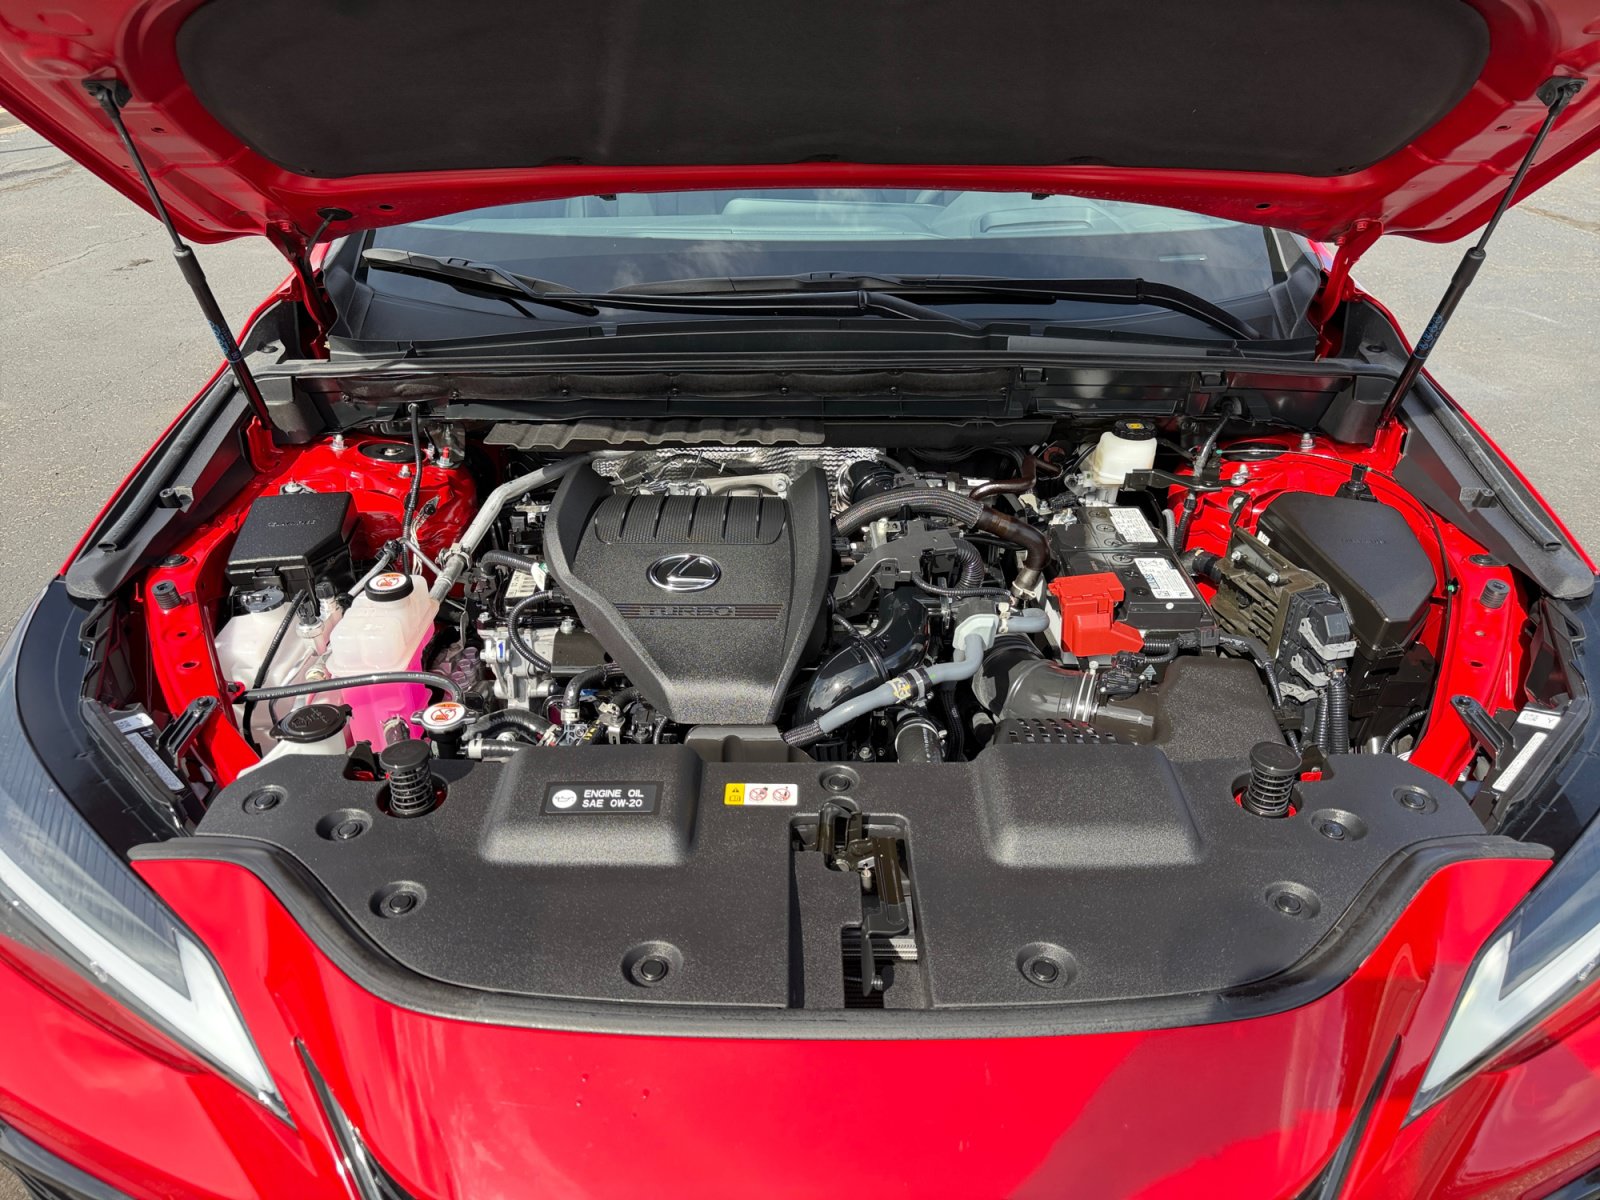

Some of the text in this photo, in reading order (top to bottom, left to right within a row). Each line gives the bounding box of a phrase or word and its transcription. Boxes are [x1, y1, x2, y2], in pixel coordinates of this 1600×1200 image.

[642, 605, 734, 617] TURBO
[584, 790, 644, 798] ENGINE OIL
[582, 799, 643, 808] SAE 0W-20
